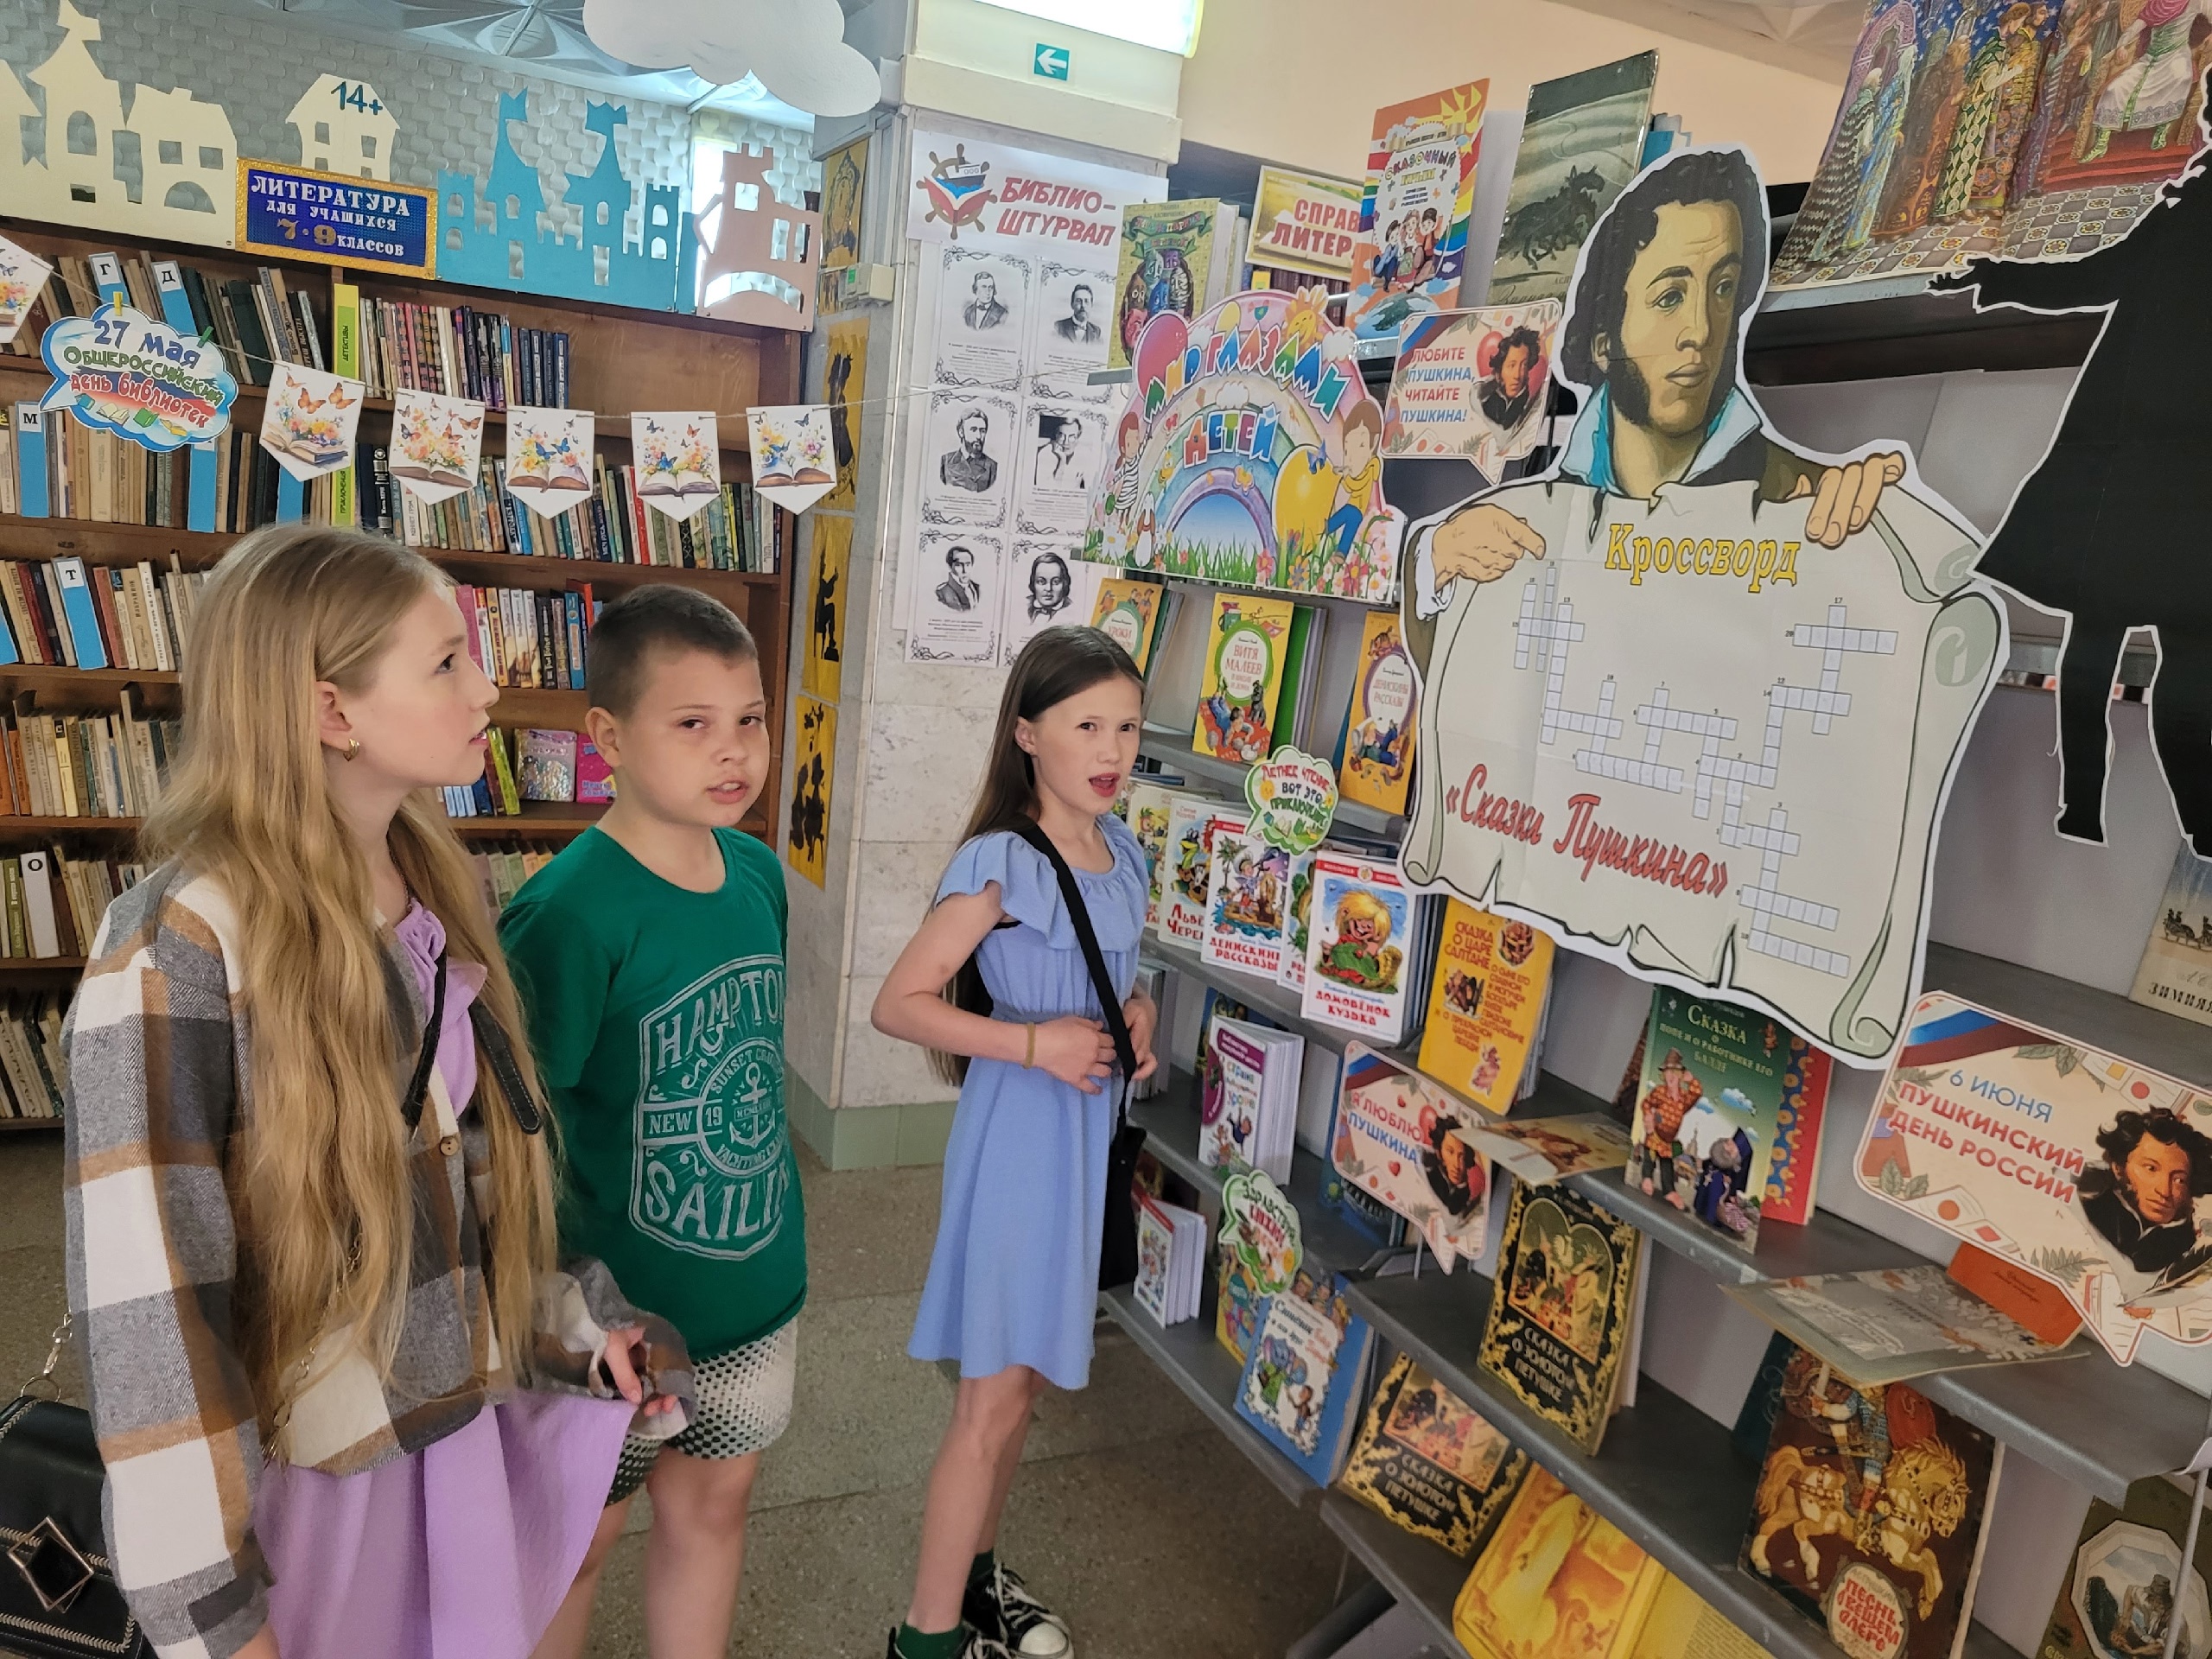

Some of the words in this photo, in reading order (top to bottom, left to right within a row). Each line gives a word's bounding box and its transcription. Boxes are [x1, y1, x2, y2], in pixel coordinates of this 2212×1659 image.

[331, 81, 383, 115] 14+
[251, 175, 410, 217] ЛИТЕРАТУРА
[266, 200, 296, 216] ДЛЯ
[1000, 177, 1116, 213] БИБЛИО-
[996, 208, 1116, 246] ШТУРВАЛ
[1271, 222, 1355, 259] ЛИТЕР
[337, 235, 404, 257] КЛАССОВ
[99, 262, 111, 277] Г
[162, 269, 175, 284] Д
[93, 320, 130, 349] 27
[1412, 347, 1465, 362] ЛЮБИТЕ
[1144, 346, 1202, 423] МИР
[1205, 322, 1352, 423] ГЛАЗАМИ
[1408, 366, 1475, 383] ПУШКИНА,
[1405, 385, 1461, 402] ЧИТАЙТЕ
[23, 413, 38, 425] М
[1401, 409, 1468, 423] ПУШКИНА!
[1182, 403, 1281, 468] ДЕТЕЙ
[1605, 523, 1801, 594] Кроссворд
[65, 569, 77, 581] Т
[1225, 658, 1262, 675] МАЛЕЕВ
[1234, 645, 1259, 661] ВИТЯ
[1282, 782, 1302, 796] ВОТ
[1304, 785, 1323, 804] ЭТО
[1452, 934, 1462, 945] О
[1465, 938, 1493, 957] ЦАРЕ
[1455, 921, 1494, 944] СКАЗКА
[1445, 944, 1491, 970] САЛТАНЕ
[1328, 1005, 1377, 1027] КУЗЬКА
[1693, 1038, 1700, 1046] О
[1711, 1034, 1719, 1044] О
[710, 1049, 753, 1094] SUNSET
[1949, 1070, 1963, 1087] 6
[1970, 1076, 2053, 1123] ИЮНЯ
[649, 1110, 692, 1135] NEW
[705, 1106, 722, 1127] 19
[1352, 1092, 1360, 1107] Я
[1363, 1098, 1421, 1141] ЛЮБЛЮ
[1898, 1083, 2084, 1175] ПУШКИНСКИЙ
[1349, 1112, 1418, 1164] ПУШКИНА
[1889, 1110, 1954, 1149] ДЕНЬ
[1959, 1139, 2075, 1204] РОССИИ
[1524, 1327, 1570, 1367] СКАЗКА
[1511, 1338, 1523, 1352] О
[1524, 1344, 1575, 1390] ЗОЛОТОМ
[1515, 1357, 1563, 1402] ПЕТУШКЕ
[1385, 1462, 1398, 1477] О
[1399, 1470, 1456, 1512] ЗОЛОТОМ
[1402, 1454, 1453, 1492] СКАЗКА
[1385, 1479, 1440, 1521] ПЕТУШКЕ
[1846, 1579, 1897, 1626] ПЕСНЬ
